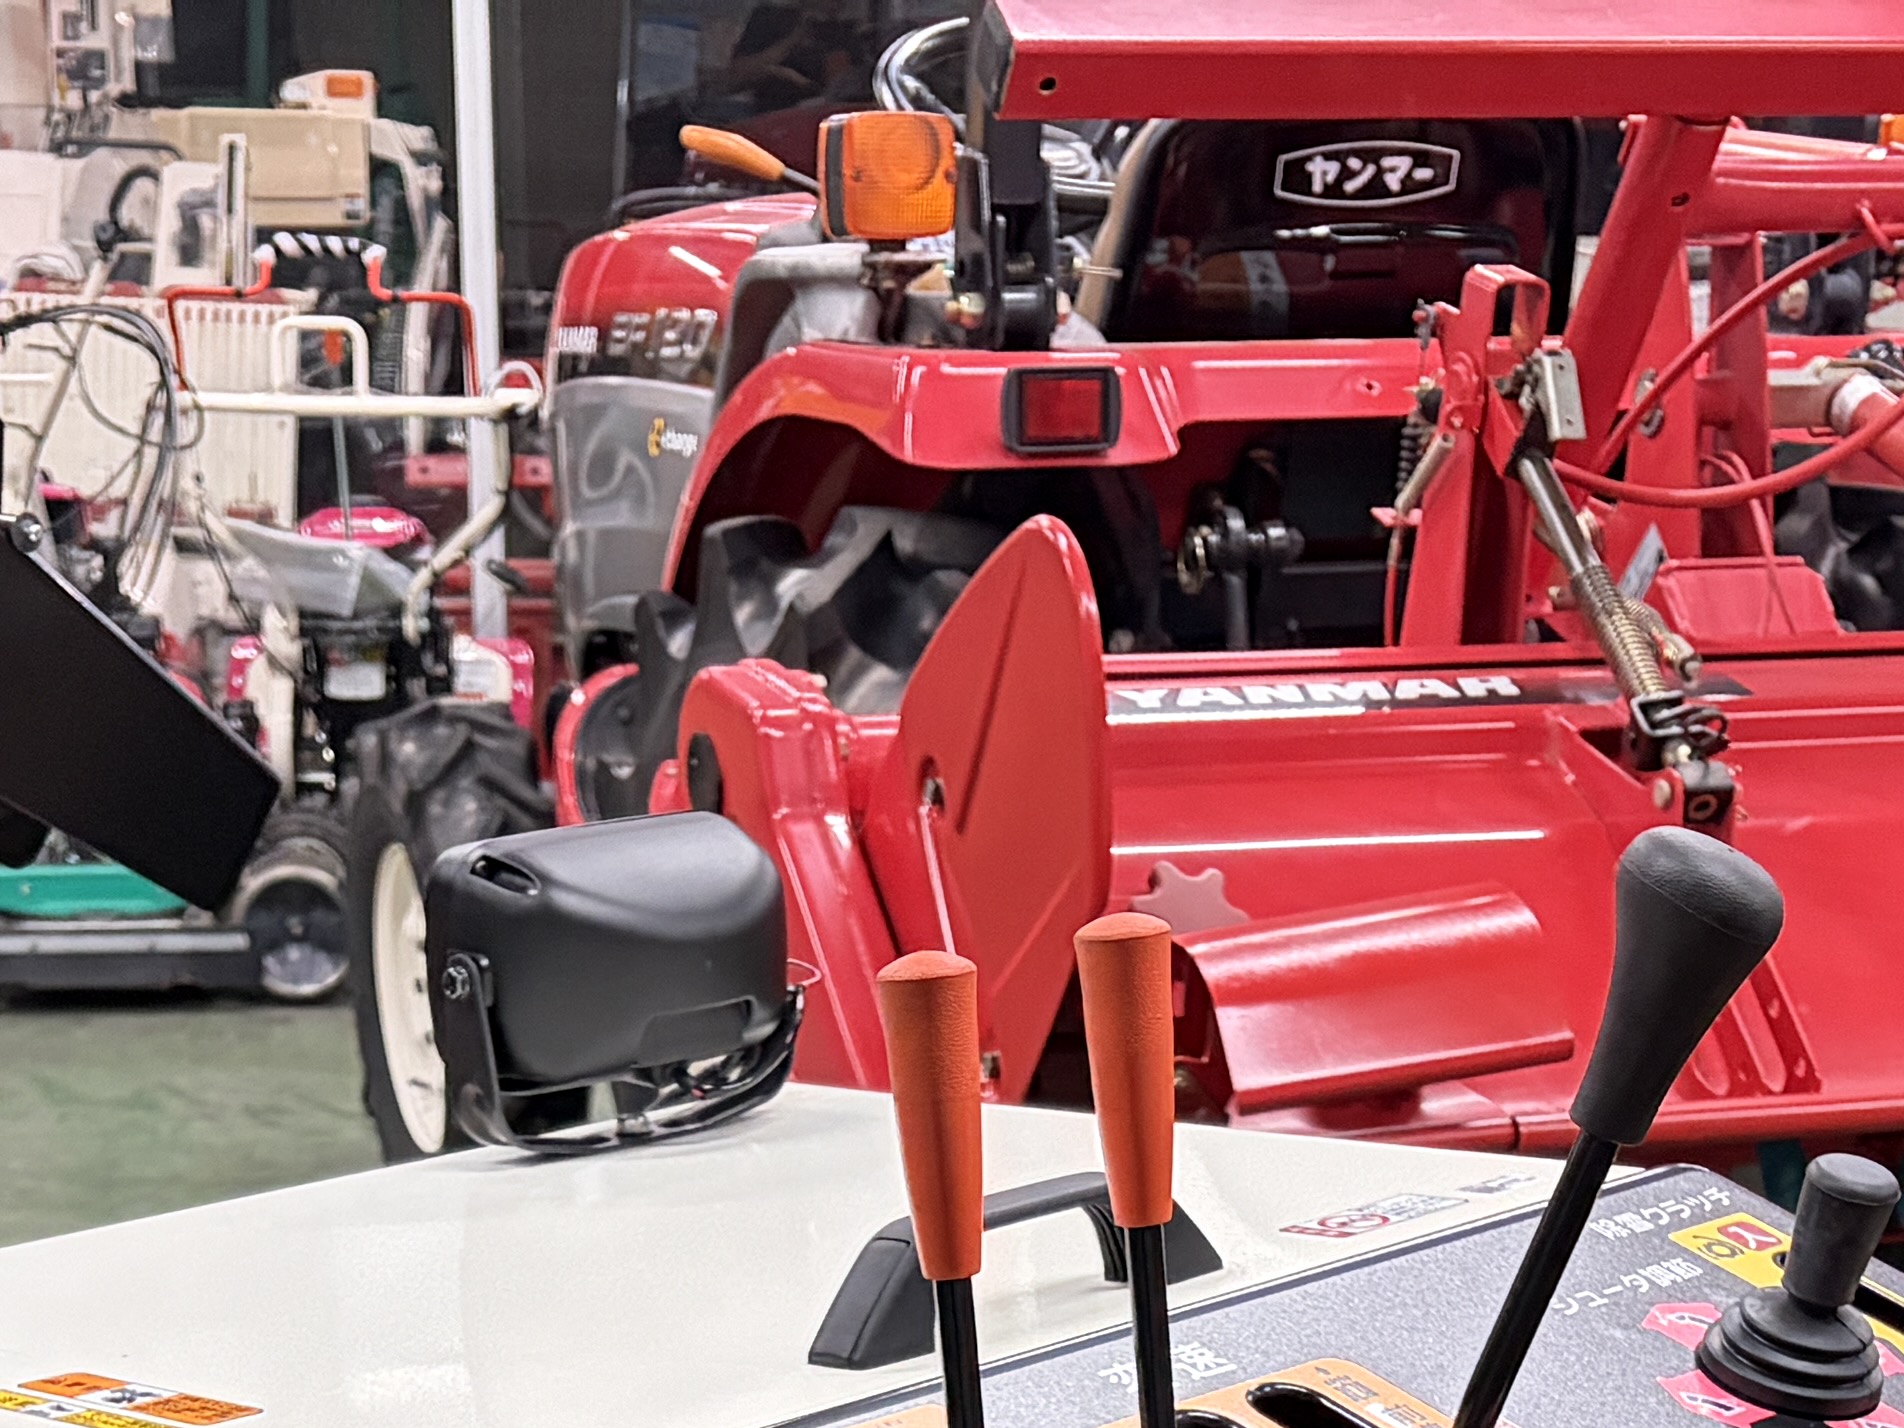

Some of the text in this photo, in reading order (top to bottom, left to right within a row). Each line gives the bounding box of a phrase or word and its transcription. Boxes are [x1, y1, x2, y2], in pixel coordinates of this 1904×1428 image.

[1306, 152, 1436, 195] ヤンマー
[1114, 675, 1522, 708] YANMAR
[1589, 1187, 1731, 1239] 除雪クラッチ
[1727, 1224, 1779, 1250] 入
